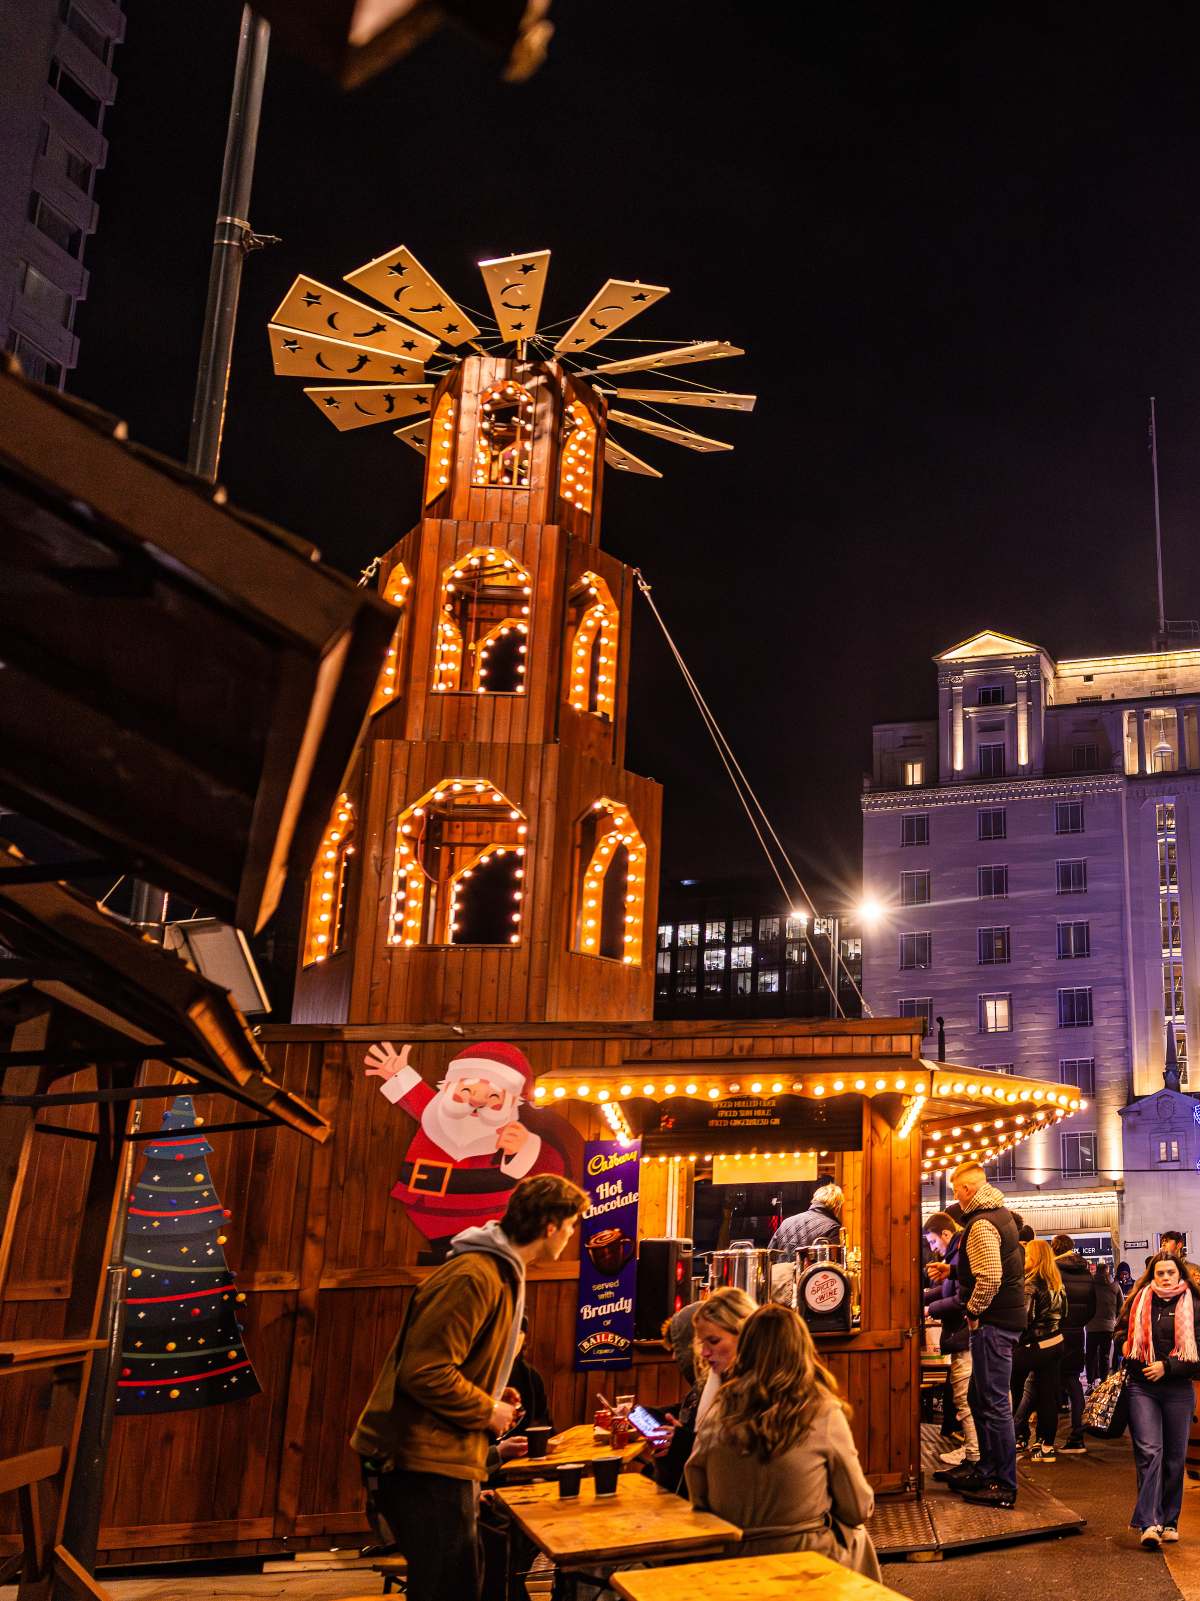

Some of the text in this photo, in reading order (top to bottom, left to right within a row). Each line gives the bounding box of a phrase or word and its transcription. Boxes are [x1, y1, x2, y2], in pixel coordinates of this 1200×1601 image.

[587, 1150, 638, 1176] Cadbury
[596, 1180, 623, 1200] Hot
[582, 1192, 640, 1219] Chocolate
[592, 1280, 620, 1291] served
[819, 1288, 838, 1301] WINE
[597, 1290, 615, 1300] with
[580, 1297, 633, 1320] Brandy
[582, 1333, 627, 1350] BAILEYS
